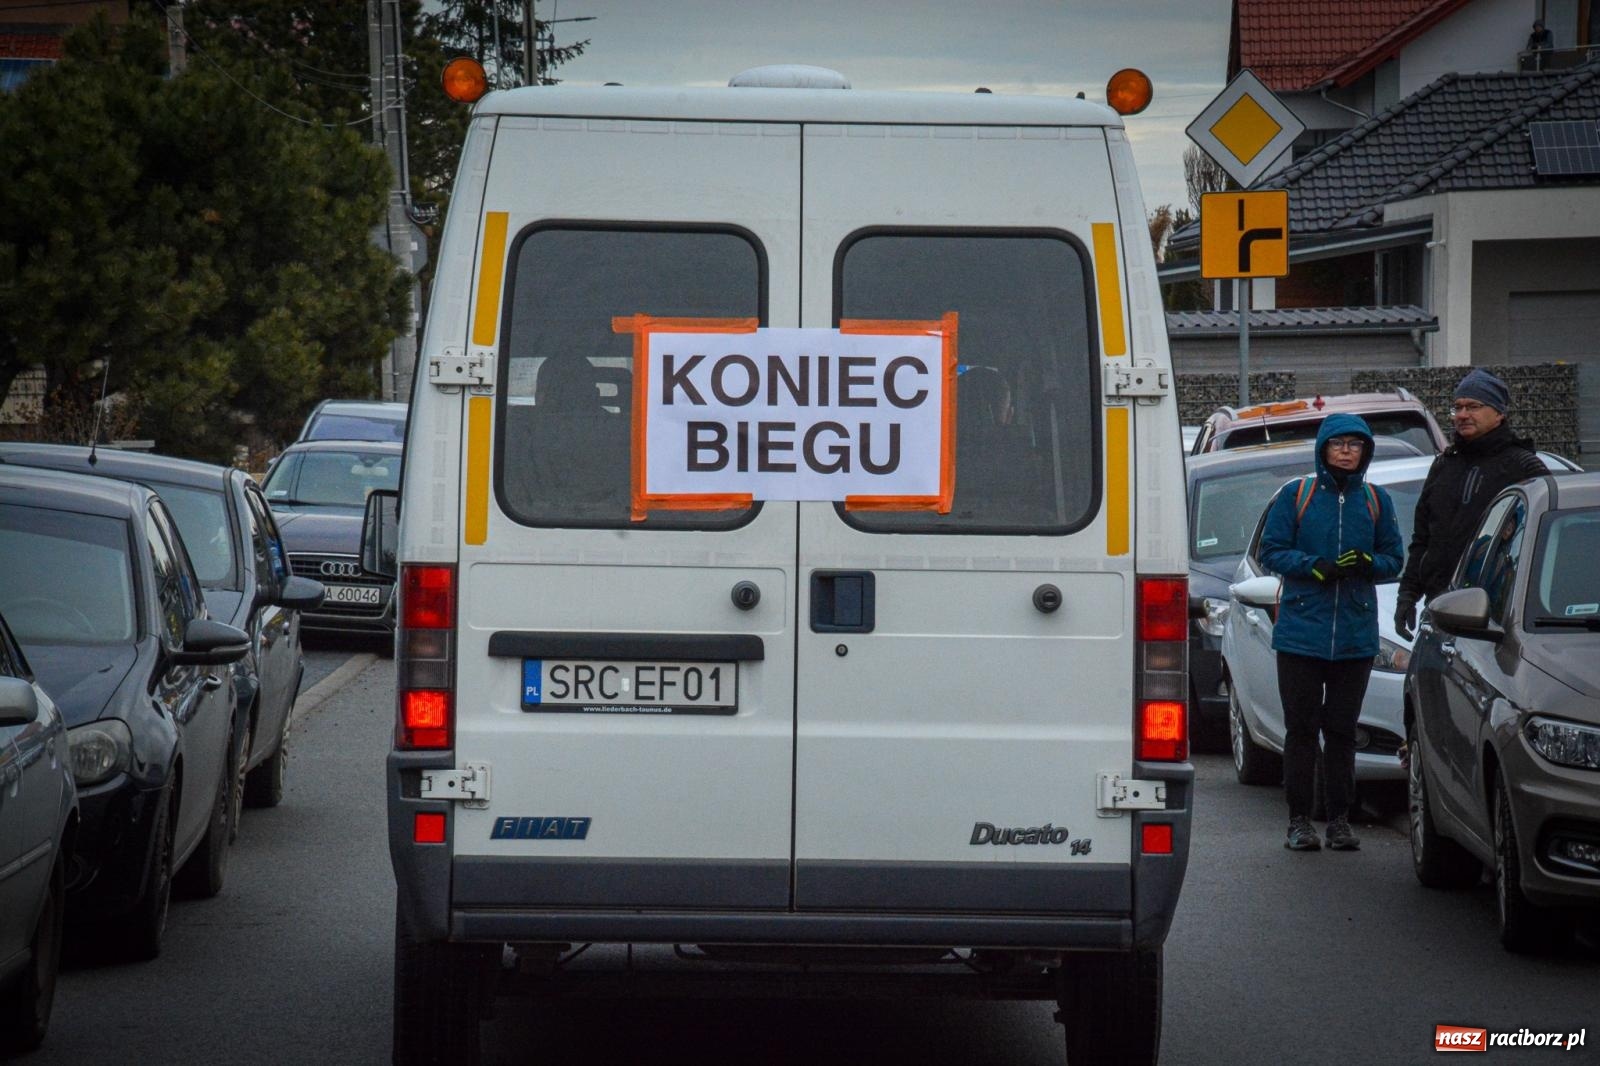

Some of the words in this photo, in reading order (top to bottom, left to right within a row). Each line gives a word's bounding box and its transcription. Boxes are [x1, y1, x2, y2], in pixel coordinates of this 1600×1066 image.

[661, 354, 929, 409] KONIEC
[686, 421, 901, 475] BIEGU
[337, 588, 377, 602] 60046
[526, 686, 538, 696] PL
[549, 664, 620, 700] SRC
[634, 665, 721, 702] EF01
[500, 820, 584, 836] FIAT
[969, 822, 1068, 845] Ducato
[1070, 839, 1091, 855] 14
